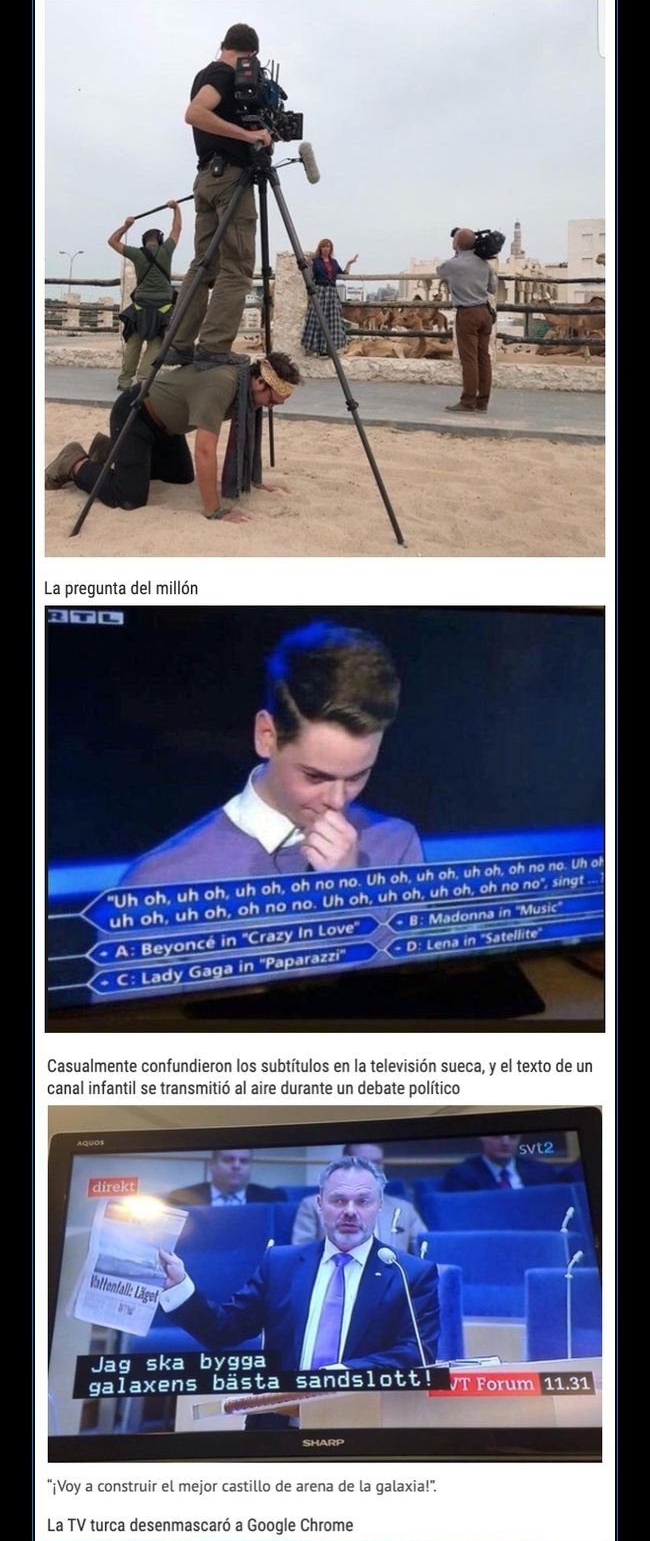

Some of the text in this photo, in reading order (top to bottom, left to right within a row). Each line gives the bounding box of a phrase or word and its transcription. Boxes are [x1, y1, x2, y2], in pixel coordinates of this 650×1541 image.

[48, 610, 124, 625] RTL
[141, 936, 215, 957] Beyoncé
[221, 935, 237, 948] in
[242, 928, 294, 945] "Crazy
[298, 926, 313, 939] In
[319, 922, 360, 937] Love"
[142, 968, 183, 985] Lady
[189, 965, 233, 980] Gaga
[239, 960, 254, 973] in
[259, 949, 346, 970] "Paparazzi"
[519, 1142, 554, 1155] svt2
[92, 1180, 136, 1193] direkt
[91, 1353, 266, 1374] Jag ska bygga
[89, 1370, 432, 1397] galaxens bästa sandslott!
[450, 1376, 590, 1391] VT Forum 11.31
[302, 1439, 344, 1448] SHARP
